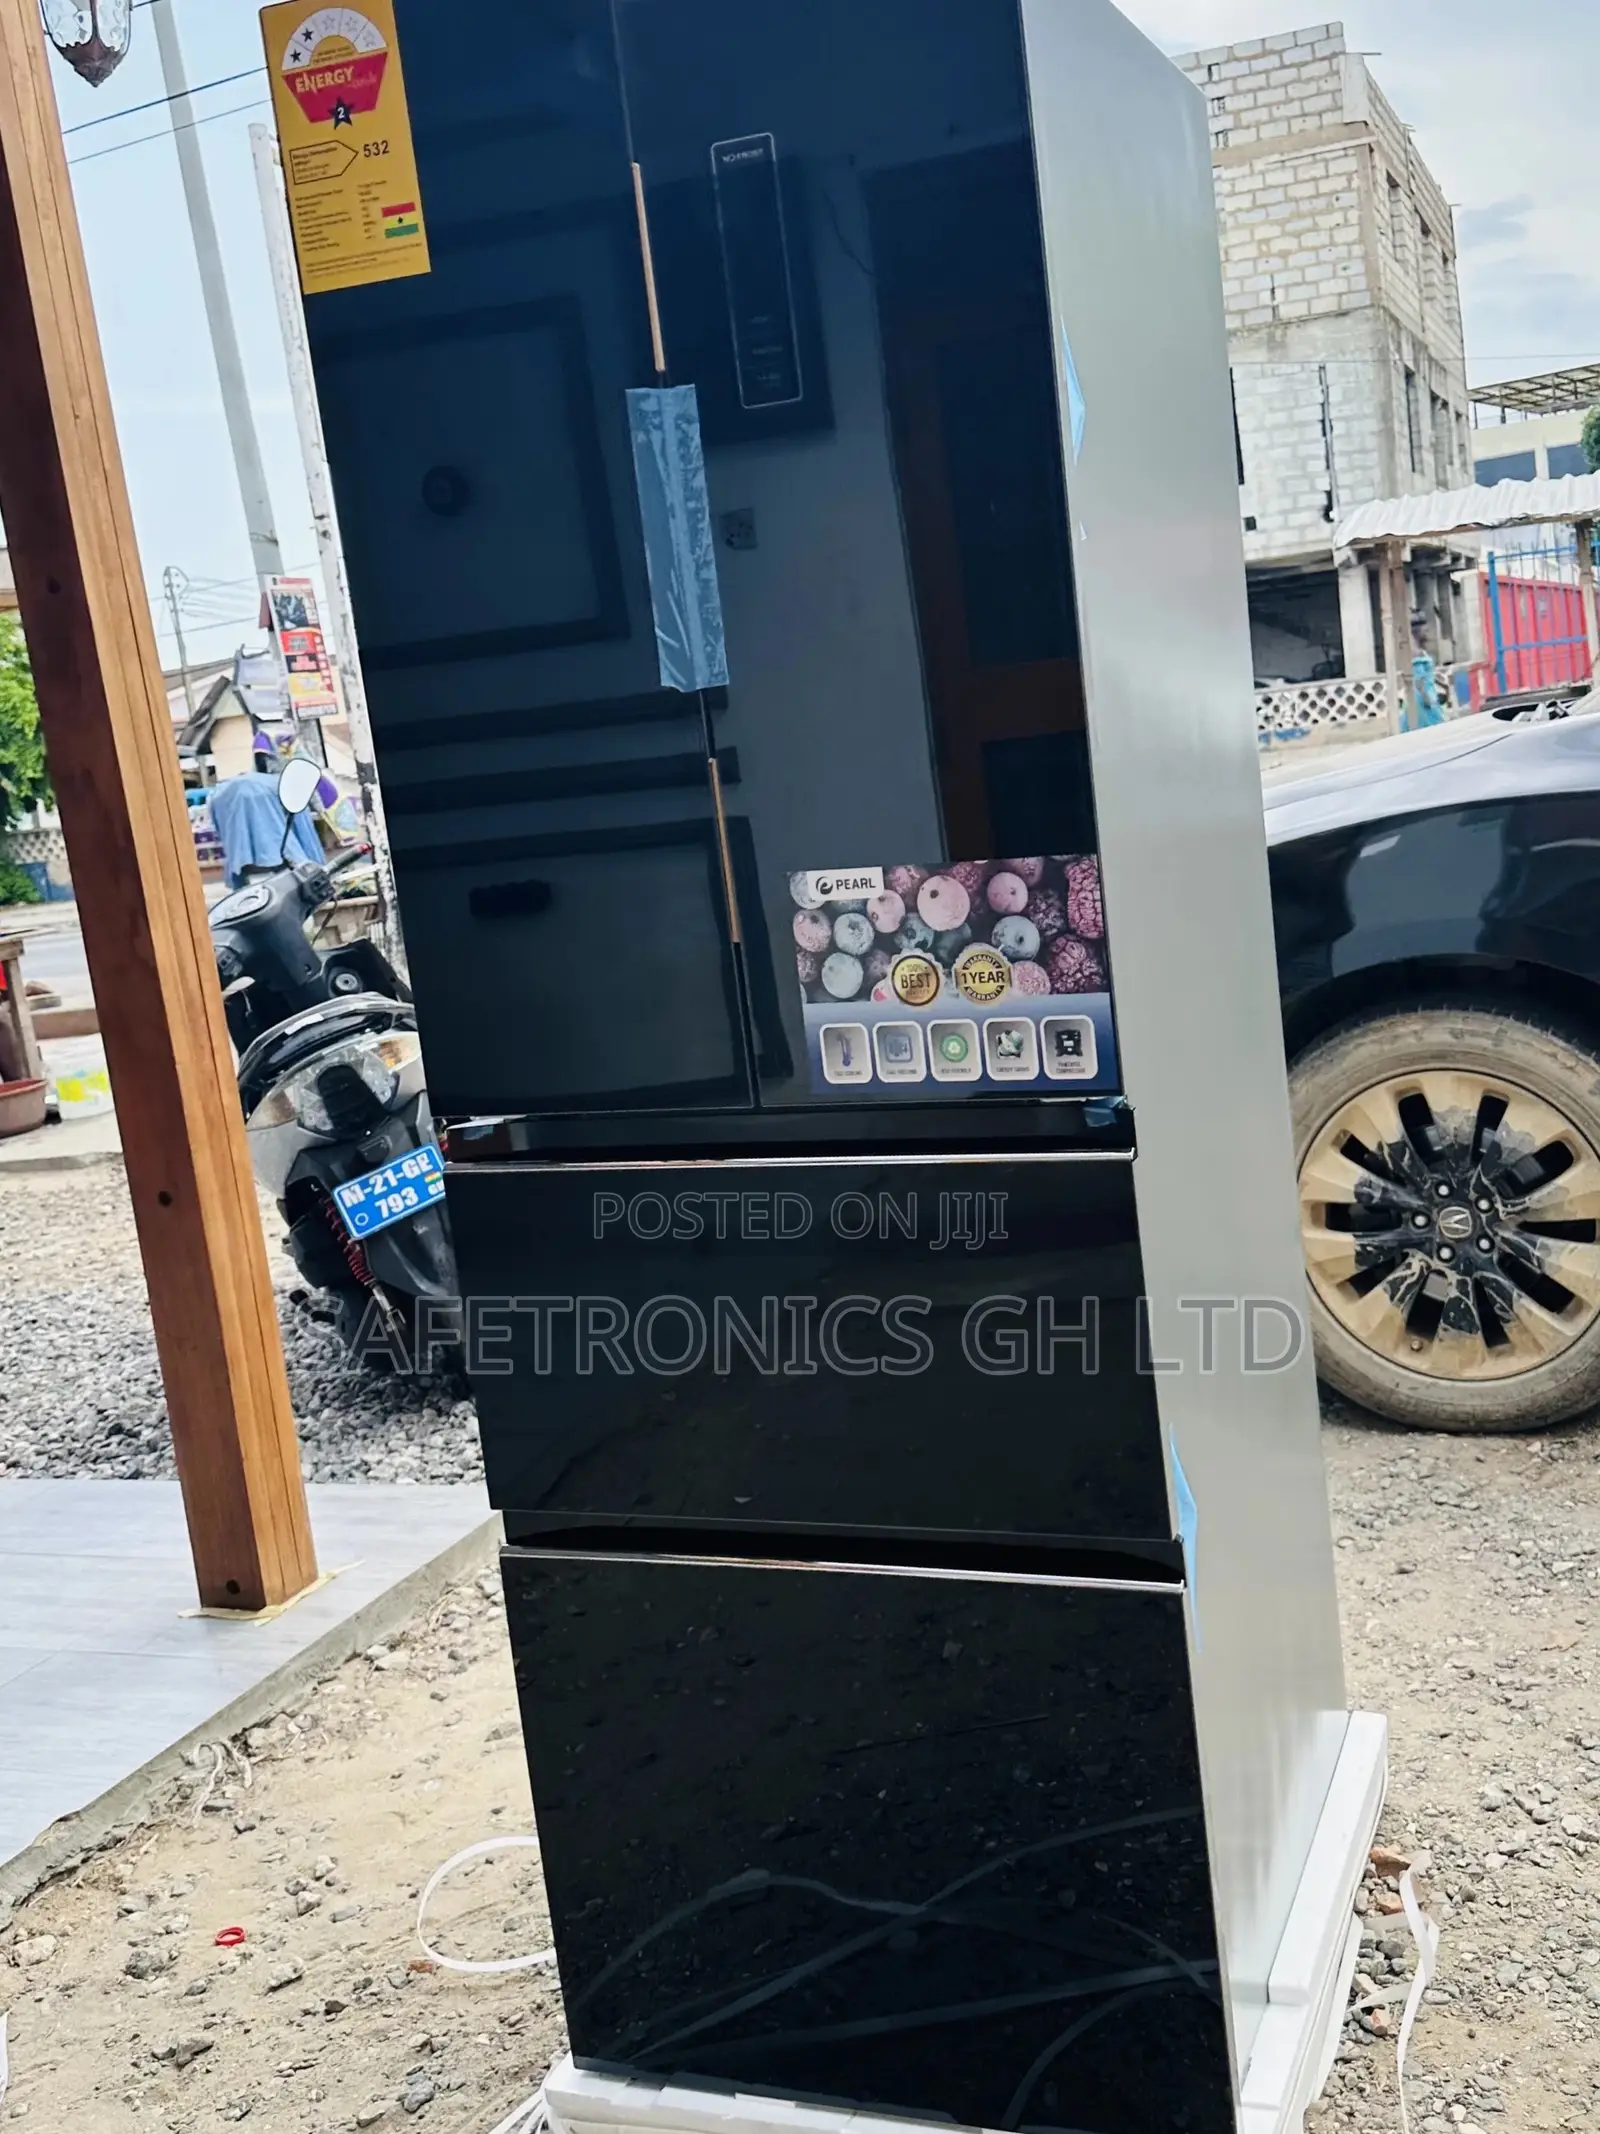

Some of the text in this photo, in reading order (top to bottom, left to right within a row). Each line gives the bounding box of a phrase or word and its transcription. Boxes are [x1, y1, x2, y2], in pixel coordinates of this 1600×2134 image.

[295, 65, 354, 94] ENERGY
[337, 107, 345, 119] 2
[363, 139, 390, 158] 532
[836, 878, 876, 890] PEARL
[901, 972, 932, 988] BEST
[961, 971, 1005, 984] 1 YEAR
[374, 1186, 419, 1219] 793
